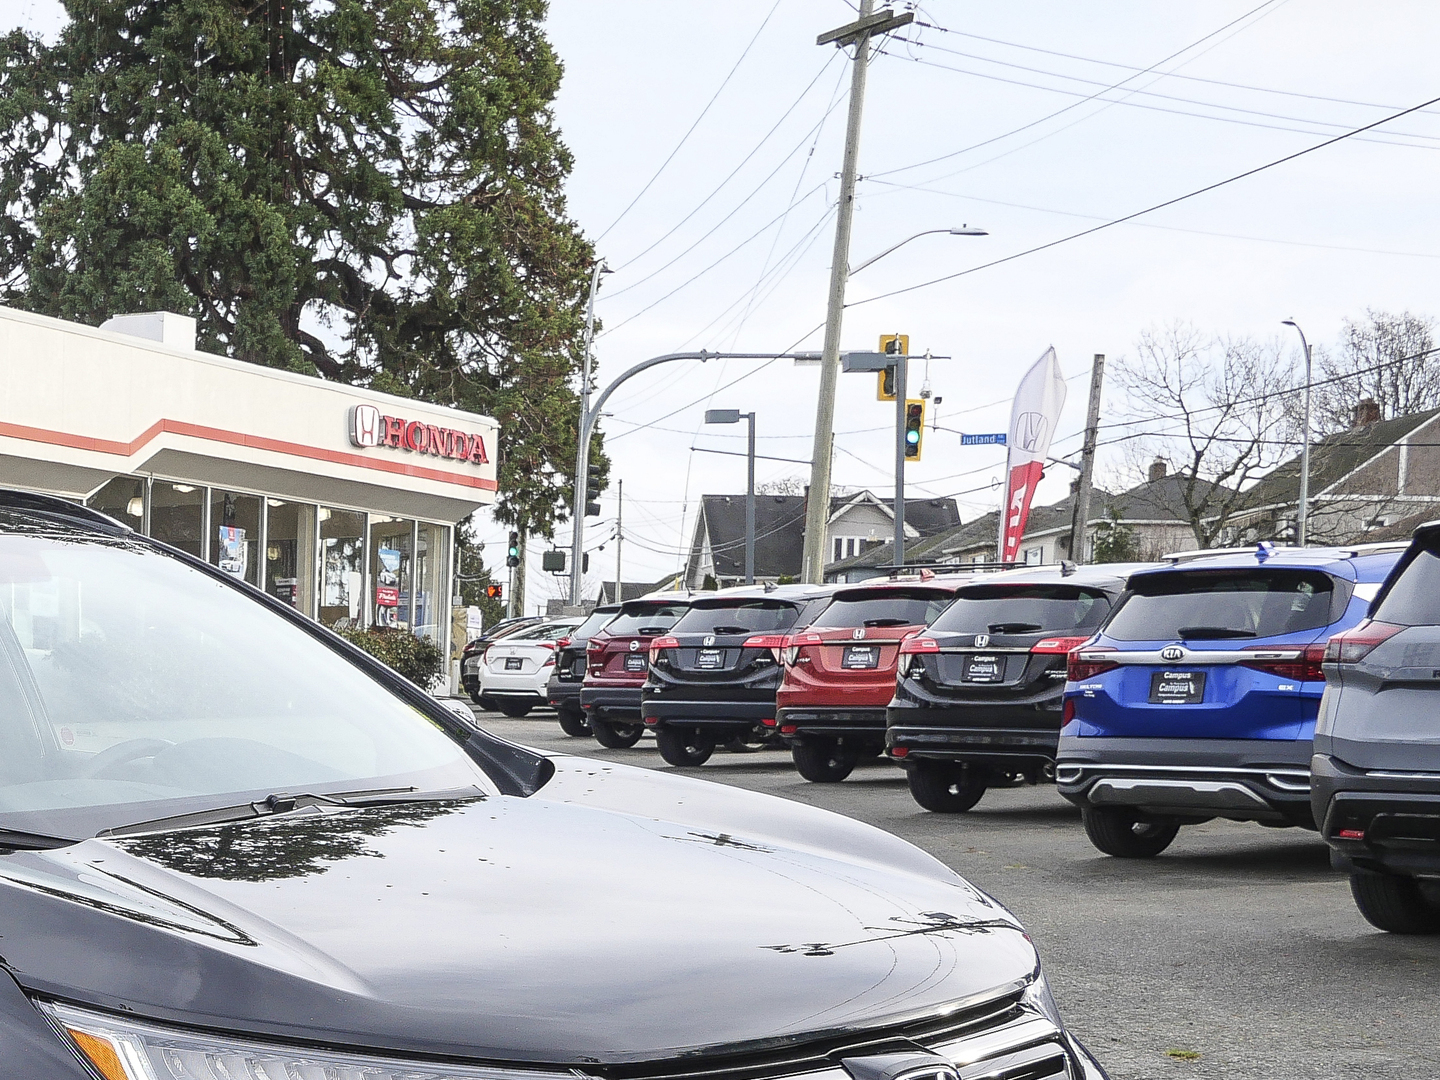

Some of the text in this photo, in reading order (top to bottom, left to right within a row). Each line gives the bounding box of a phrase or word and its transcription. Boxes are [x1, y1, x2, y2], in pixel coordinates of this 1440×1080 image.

[383, 415, 490, 465] HONDA
[962, 434, 996, 445] Jutland
[1163, 649, 1182, 659] KIA
[1163, 671, 1192, 680] Campus
[1158, 682, 1189, 694] Campus
